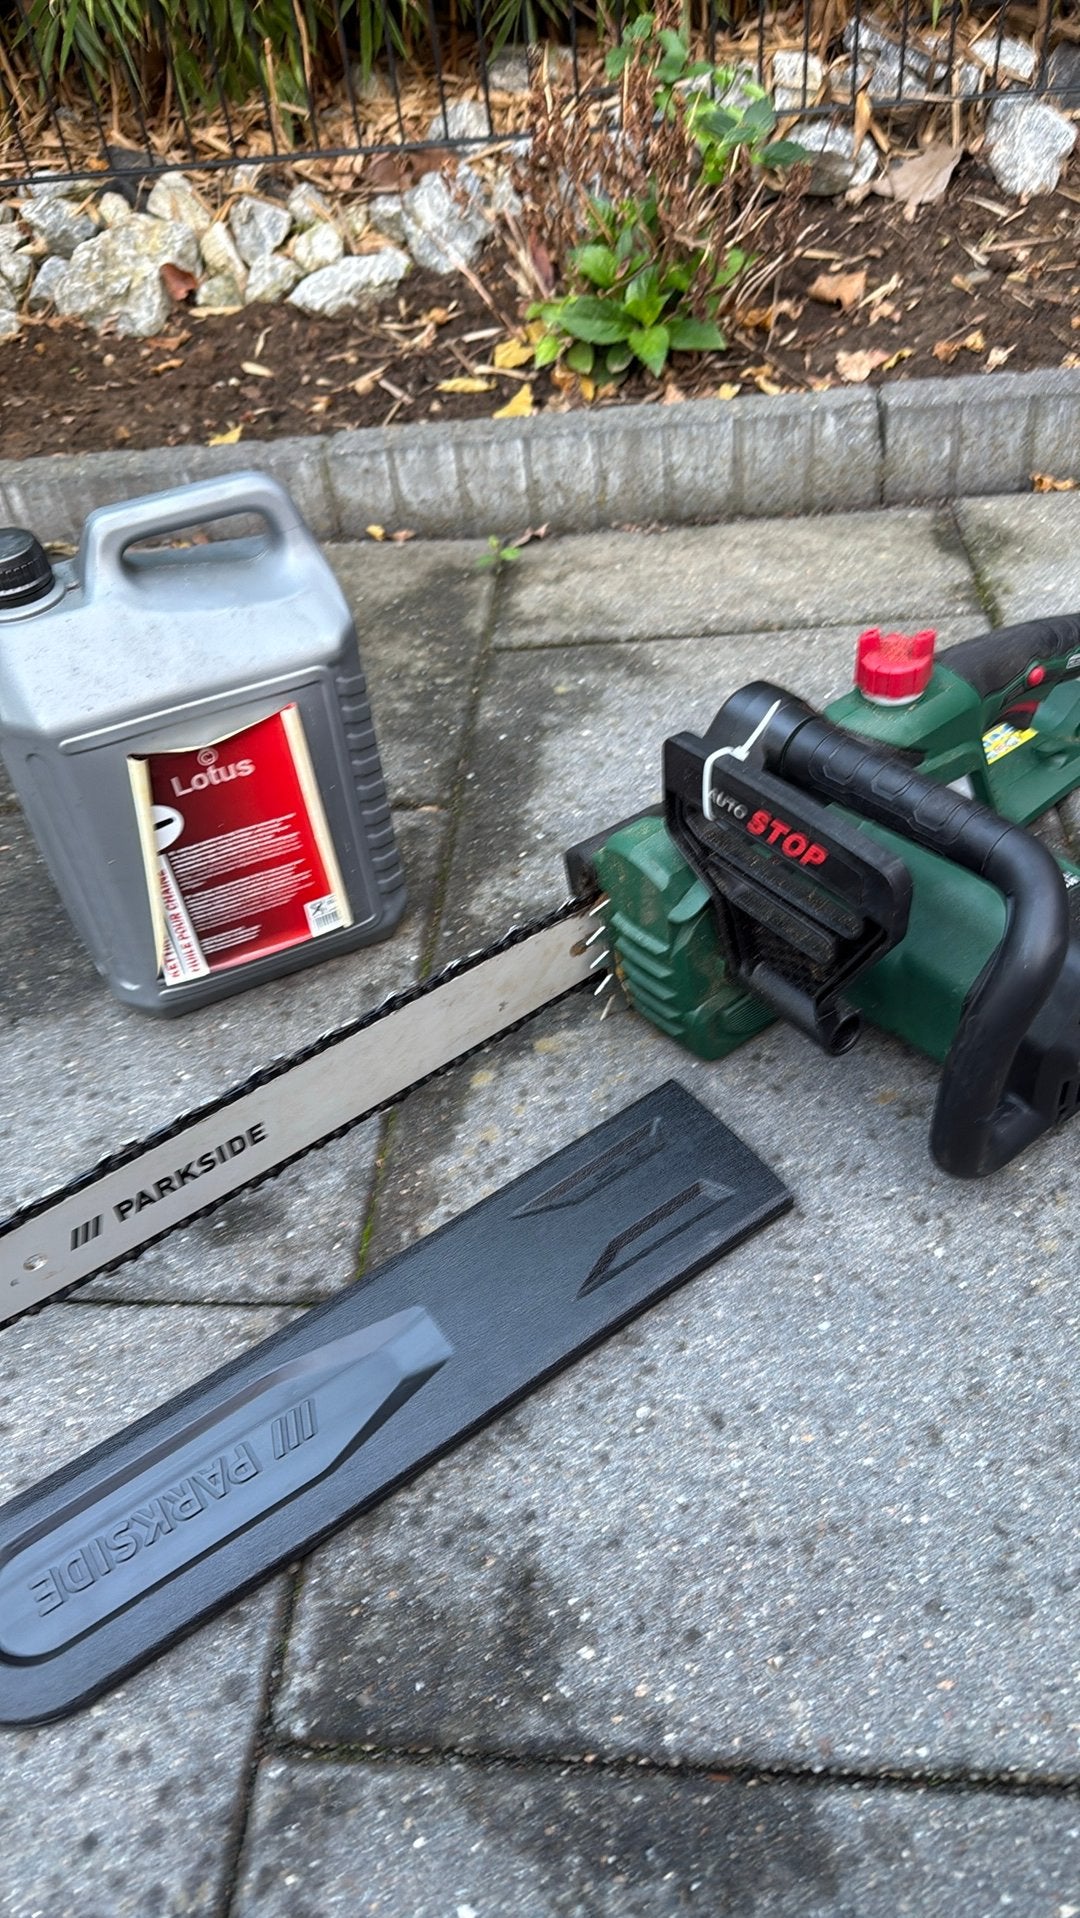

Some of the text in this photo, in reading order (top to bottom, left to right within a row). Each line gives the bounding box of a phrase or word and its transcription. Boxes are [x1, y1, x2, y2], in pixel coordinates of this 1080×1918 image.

[170, 758, 256, 797] Lotus
[746, 808, 829, 867] STOP
[168, 912, 191, 940] POUR
[112, 1121, 268, 1223] PARKSIDE
[28, 1443, 264, 1618] PARKSIDE
